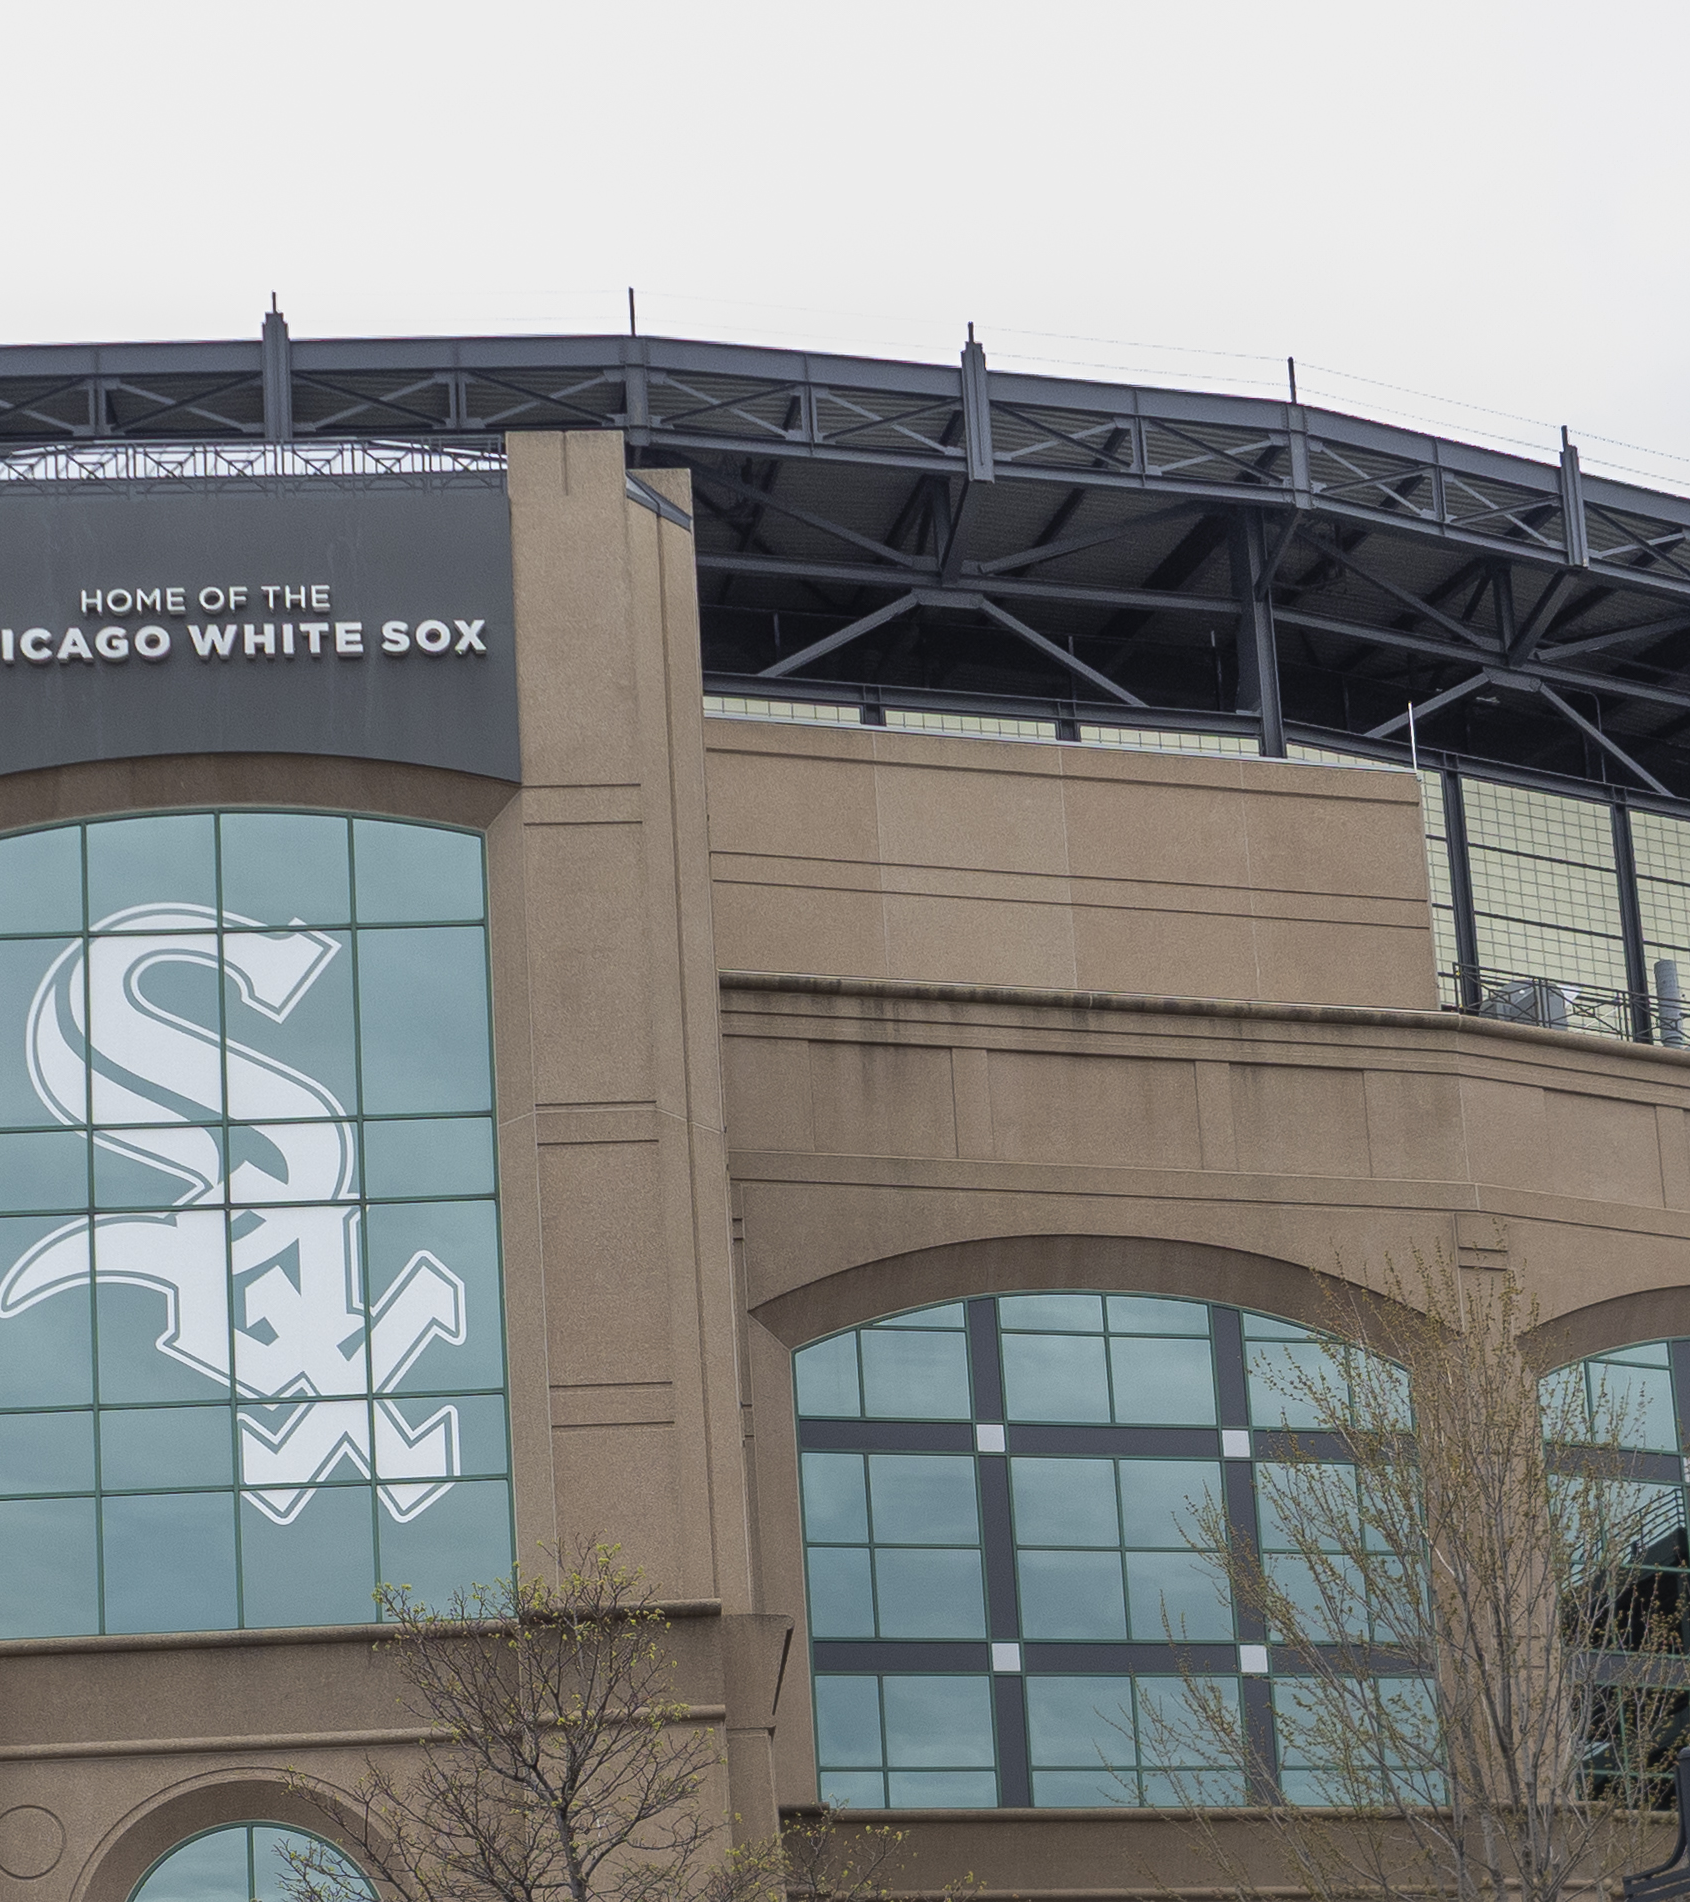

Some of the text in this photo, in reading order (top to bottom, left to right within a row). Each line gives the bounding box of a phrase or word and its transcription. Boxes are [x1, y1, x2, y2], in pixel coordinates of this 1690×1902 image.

[79, 583, 332, 616] HOME OF THE
[186, 620, 365, 661] WHITE
[380, 618, 488, 656] SOX
